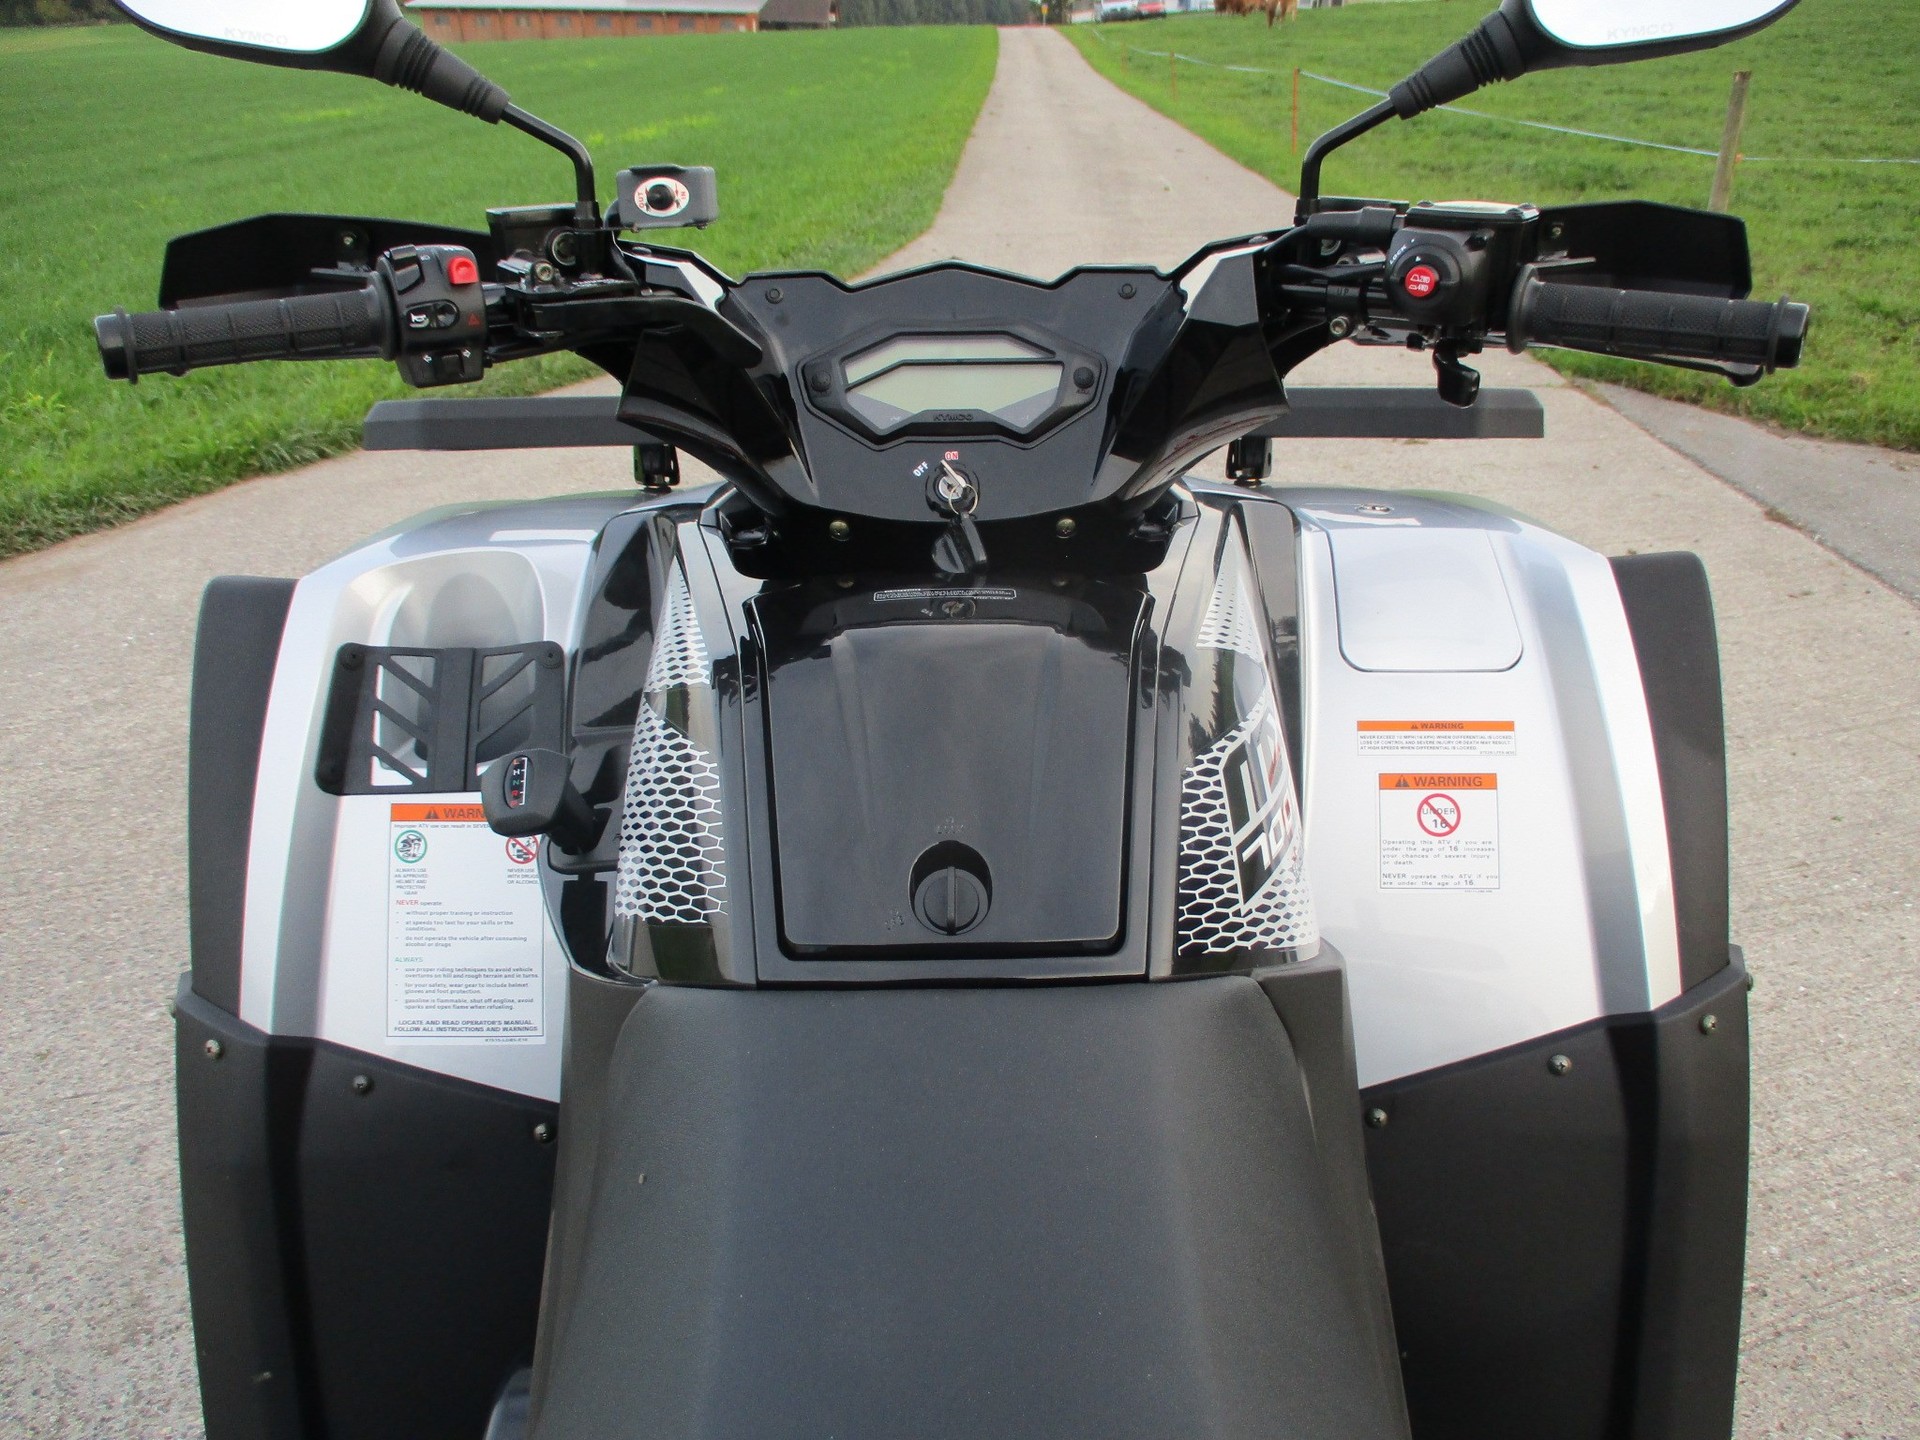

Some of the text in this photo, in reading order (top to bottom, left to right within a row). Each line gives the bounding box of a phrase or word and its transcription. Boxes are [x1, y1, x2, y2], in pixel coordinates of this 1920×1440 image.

[223, 27, 288, 45] KYMCO
[1390, 244, 1406, 264] LOCK
[944, 451, 958, 460] ON
[913, 461, 928, 476] OFF
[1414, 776, 1482, 787] WARNING
[444, 808, 484, 818] WARN
[1432, 819, 1448, 828] 16
